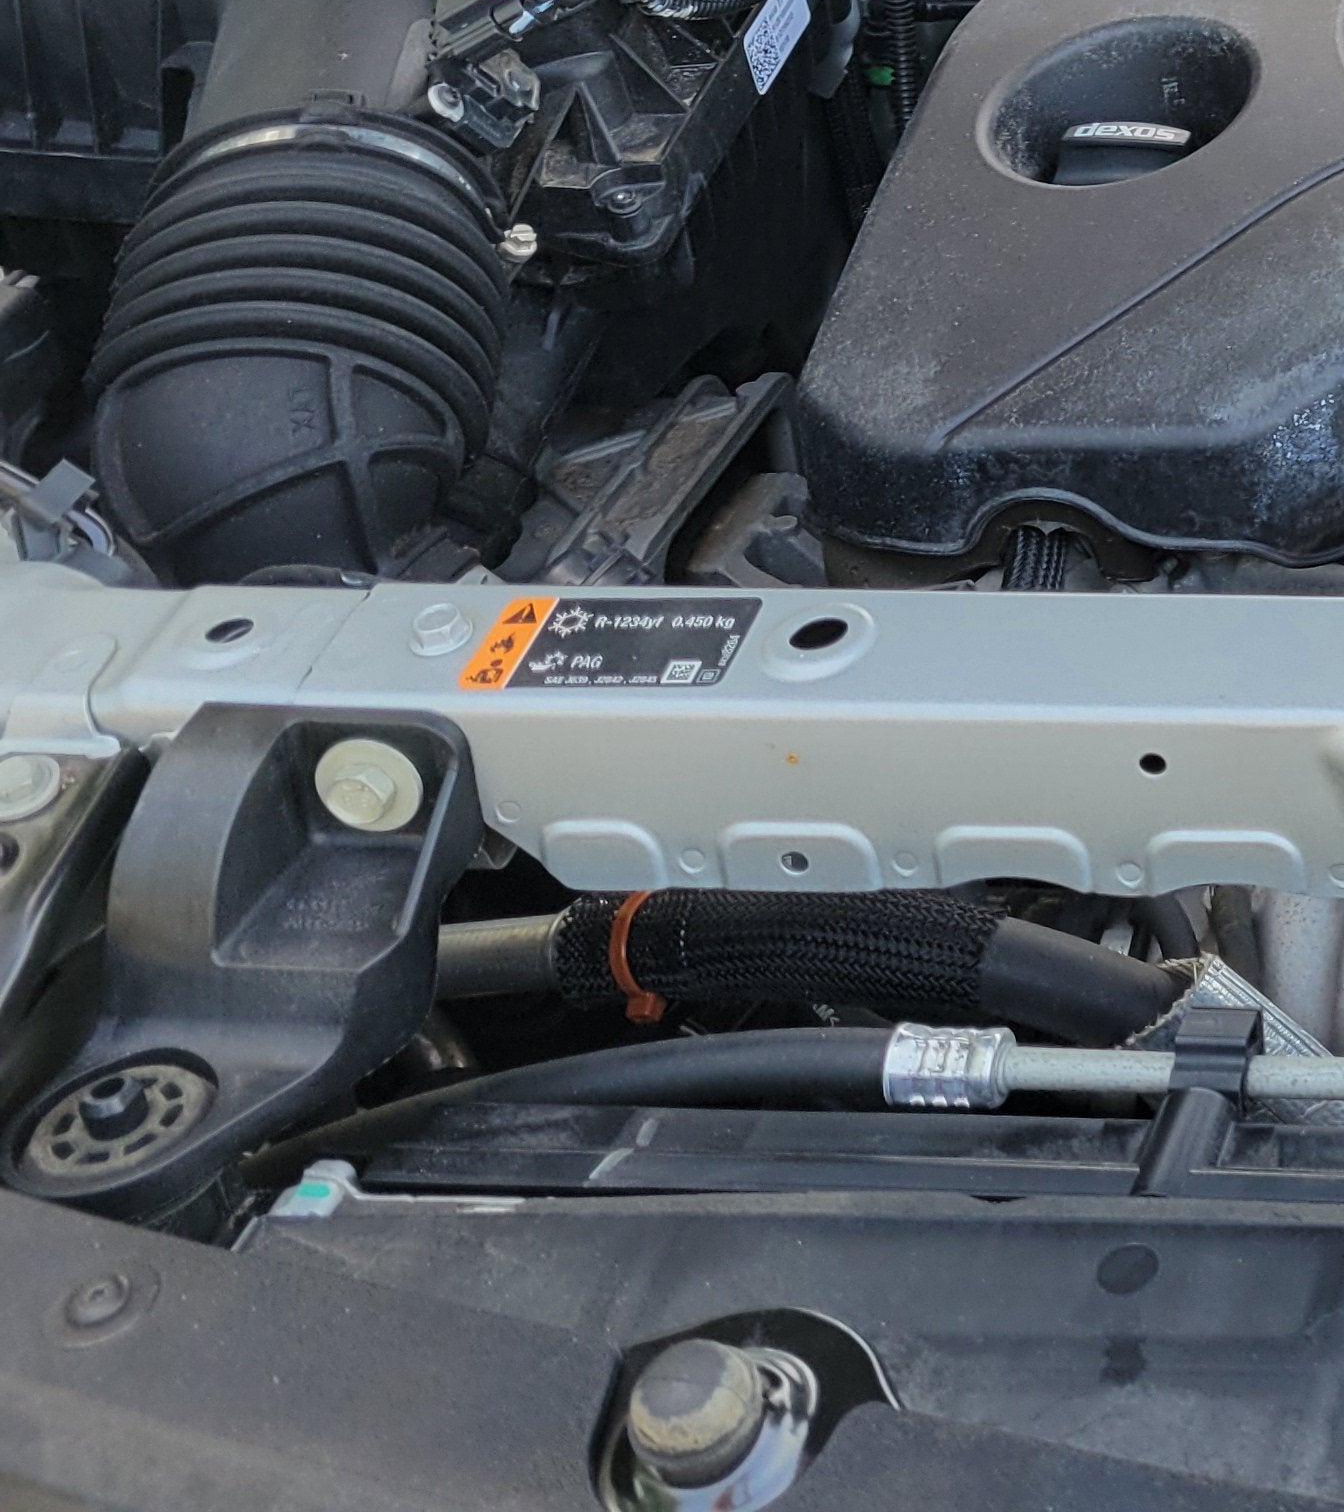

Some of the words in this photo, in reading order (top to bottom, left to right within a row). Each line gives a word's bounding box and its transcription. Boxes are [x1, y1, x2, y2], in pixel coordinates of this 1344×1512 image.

[1074, 122, 1177, 140] dexos
[595, 615, 664, 630] R-1234yf
[671, 616, 713, 628] 0.450
[715, 616, 736, 630] kg
[571, 655, 602, 669] PAG
